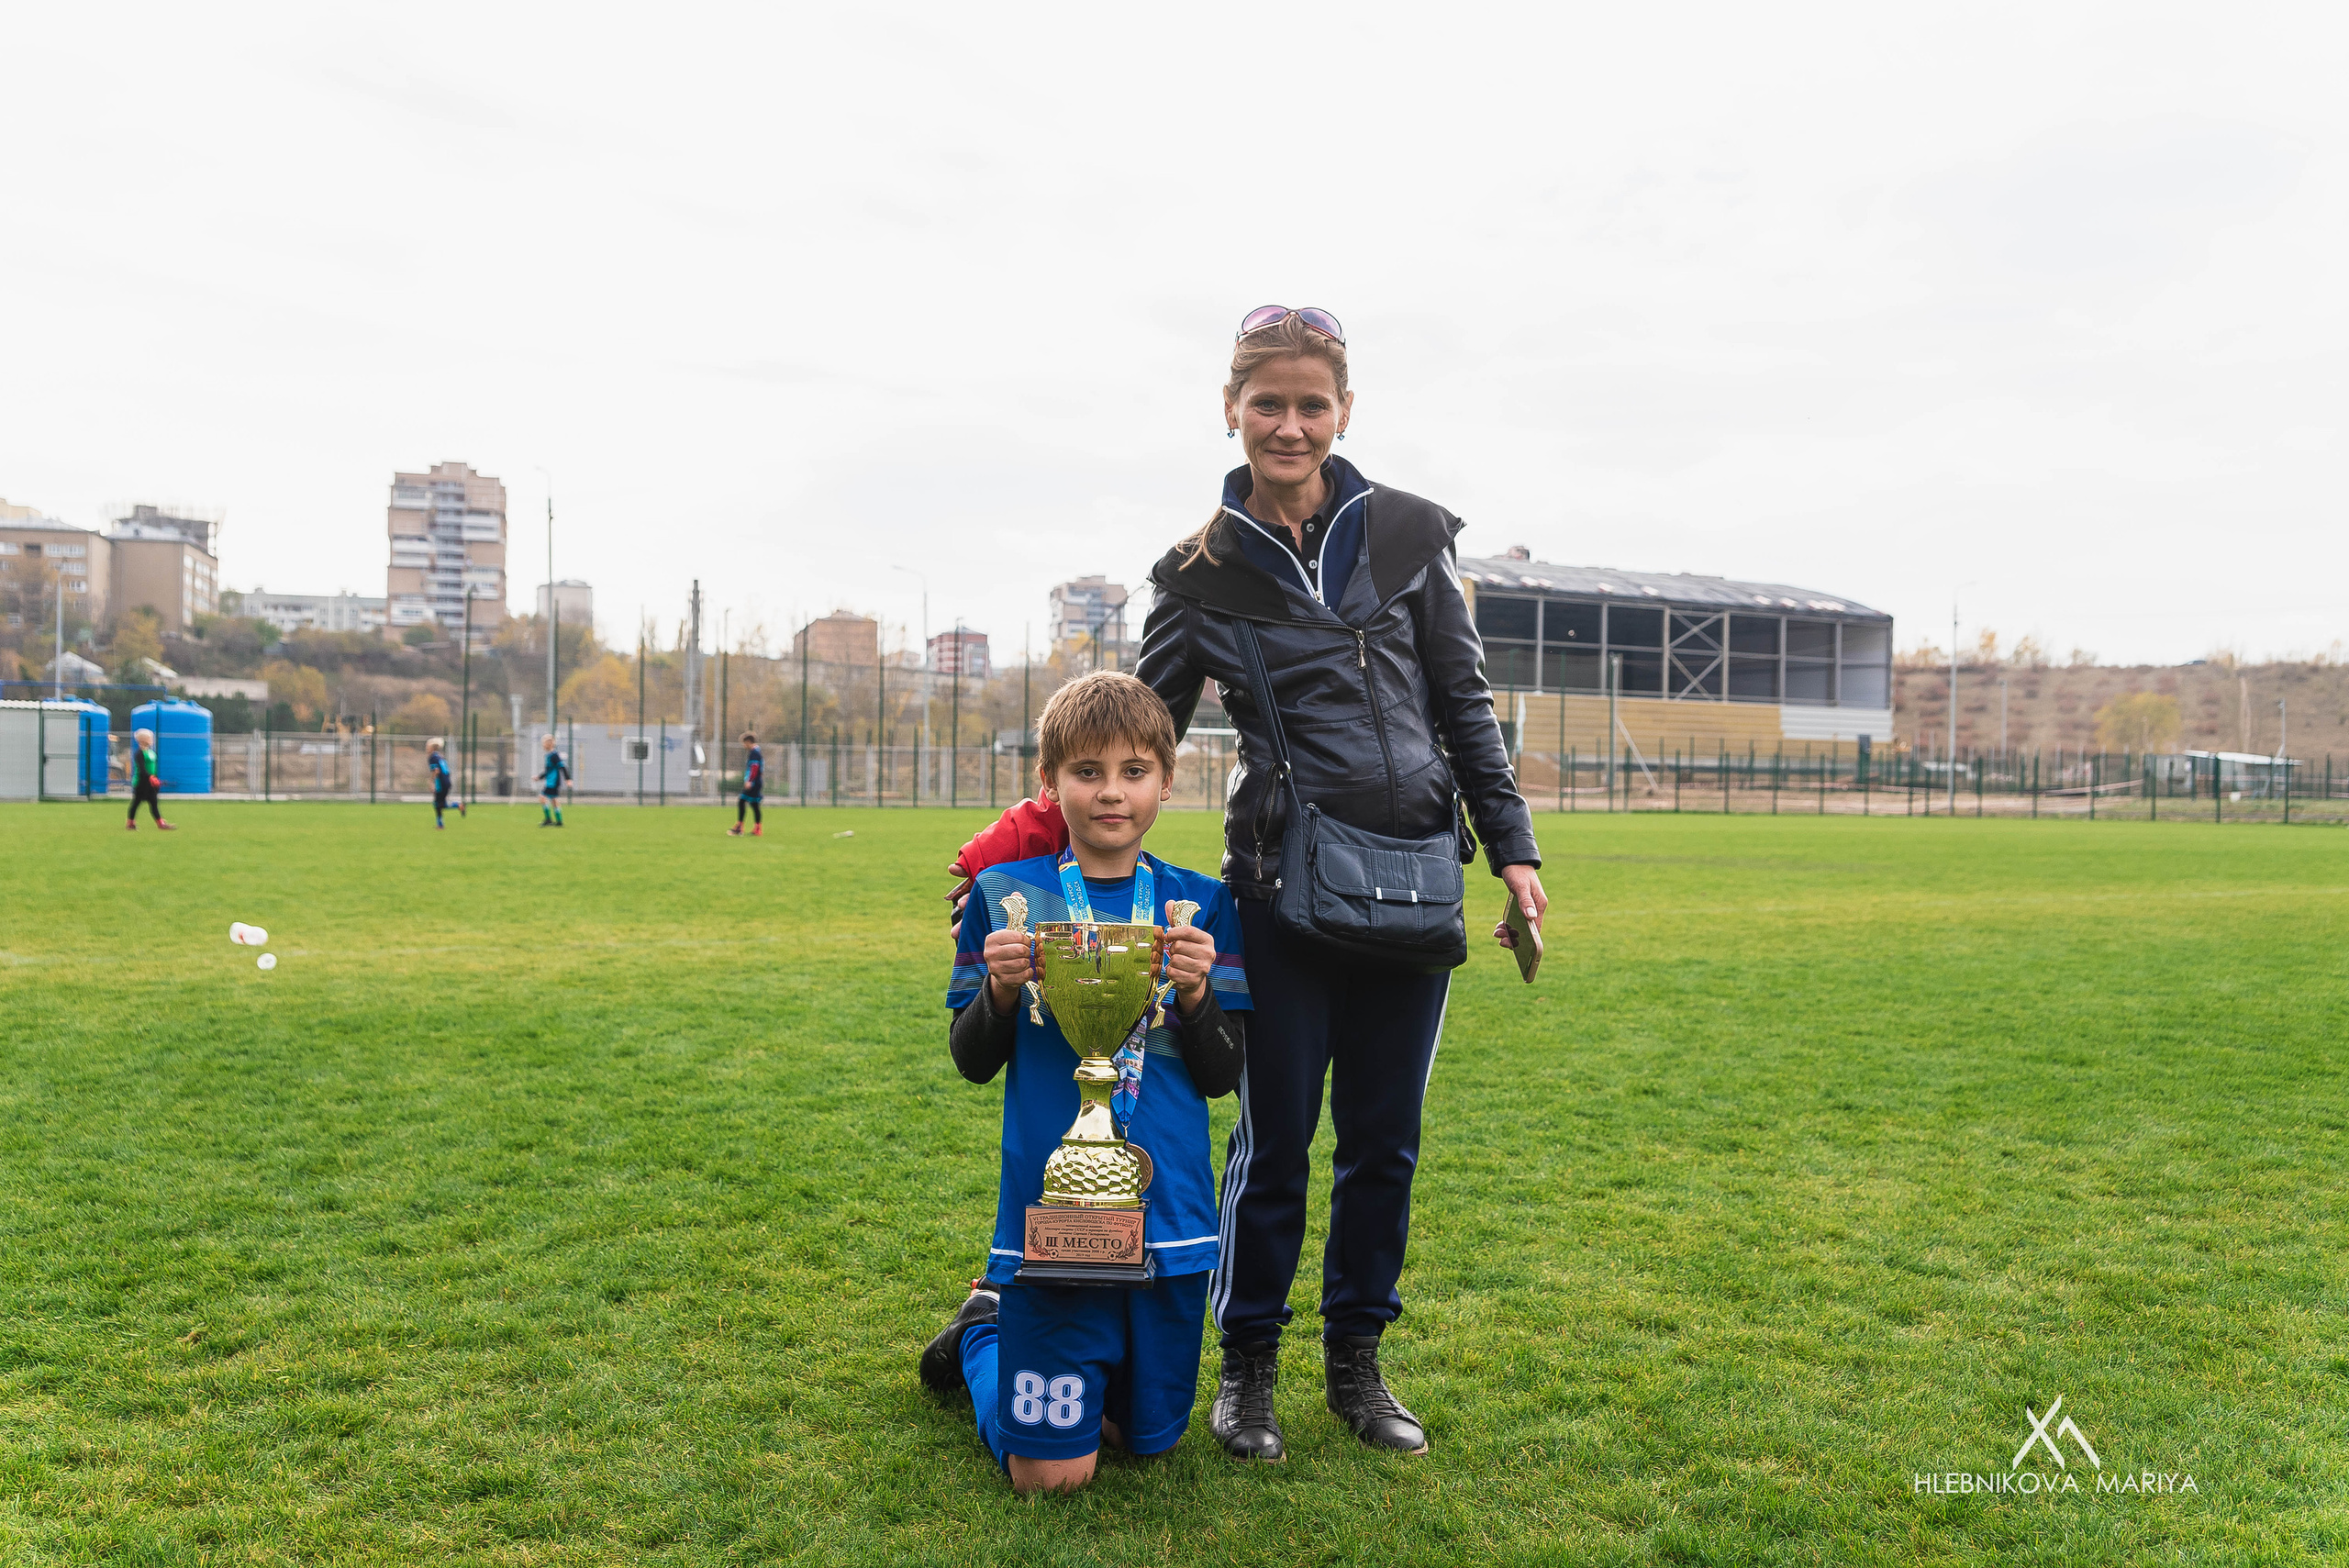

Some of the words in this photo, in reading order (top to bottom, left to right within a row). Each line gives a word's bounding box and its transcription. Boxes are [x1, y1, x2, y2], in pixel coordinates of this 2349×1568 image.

[1045, 1236, 1059, 1248] III
[1062, 1237, 1122, 1250] МЕСТО
[1011, 1369, 1085, 1429] 88
